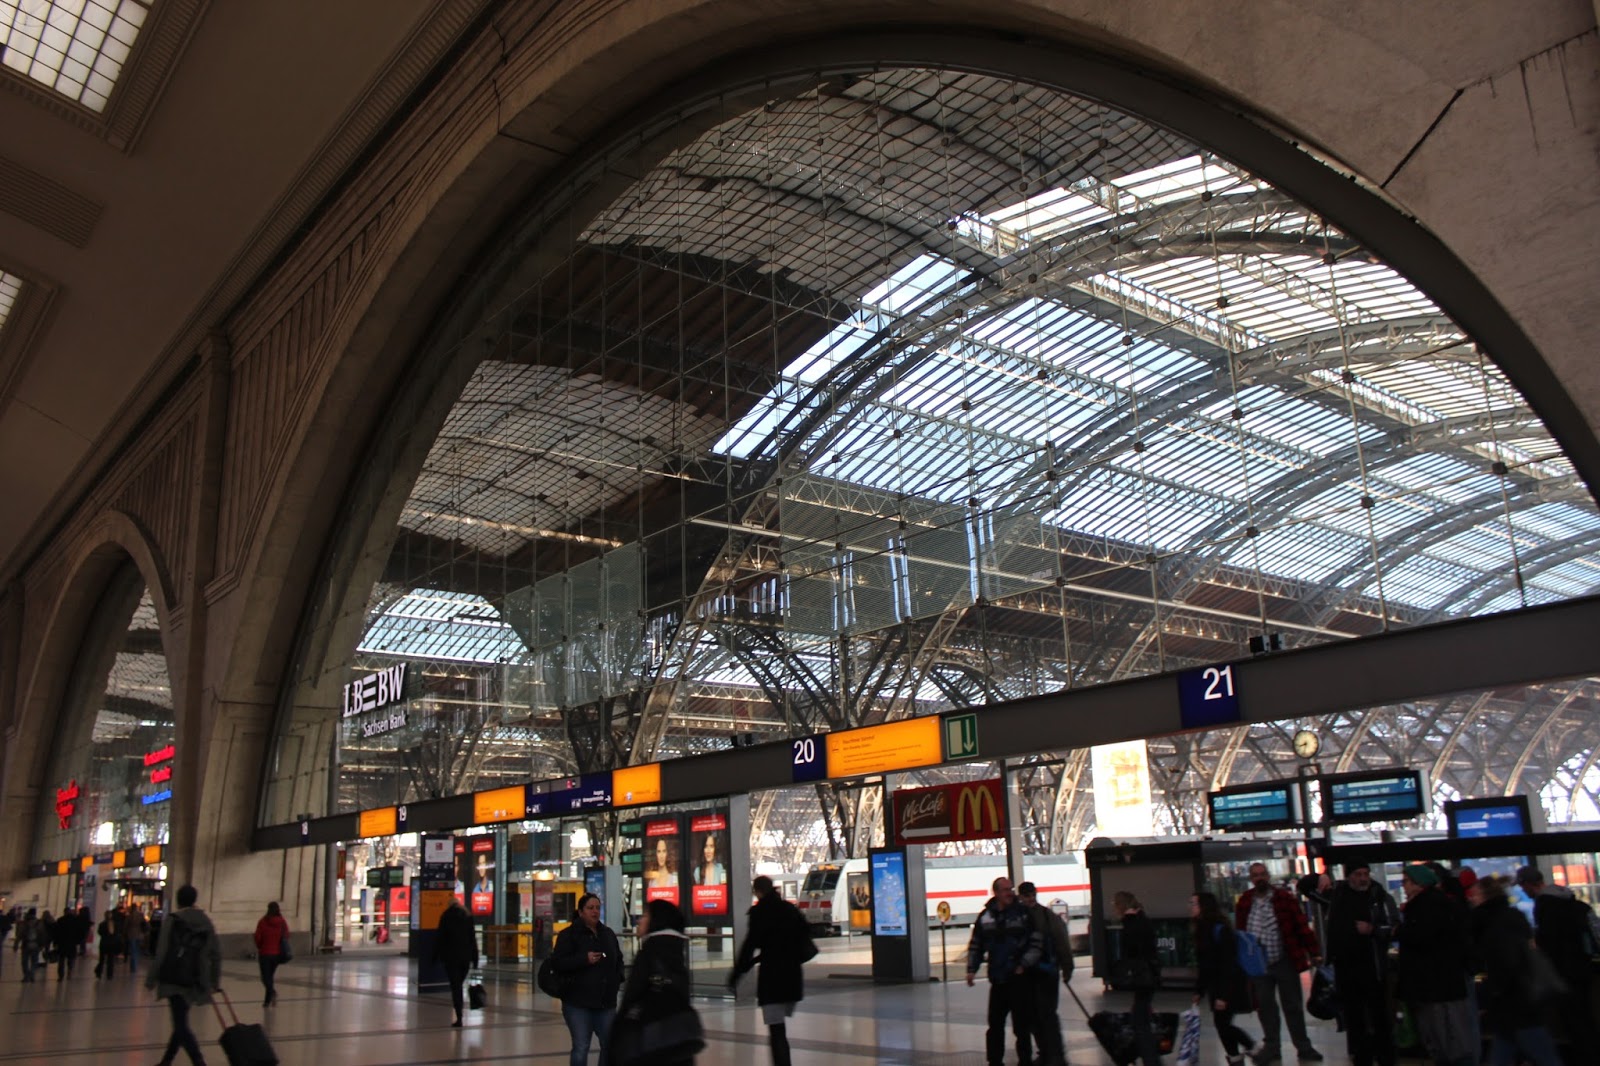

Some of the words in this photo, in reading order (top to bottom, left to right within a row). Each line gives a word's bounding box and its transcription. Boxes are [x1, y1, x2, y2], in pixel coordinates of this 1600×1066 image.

[1203, 665, 1234, 700] 21
[363, 719, 389, 738] Sachsen
[389, 710, 406, 729] Bank
[794, 738, 815, 764] 20
[1403, 777, 1416, 789] 21
[398, 806, 407, 821] 19
[902, 791, 944, 824] McCafé
[1213, 797, 1224, 807] 20
